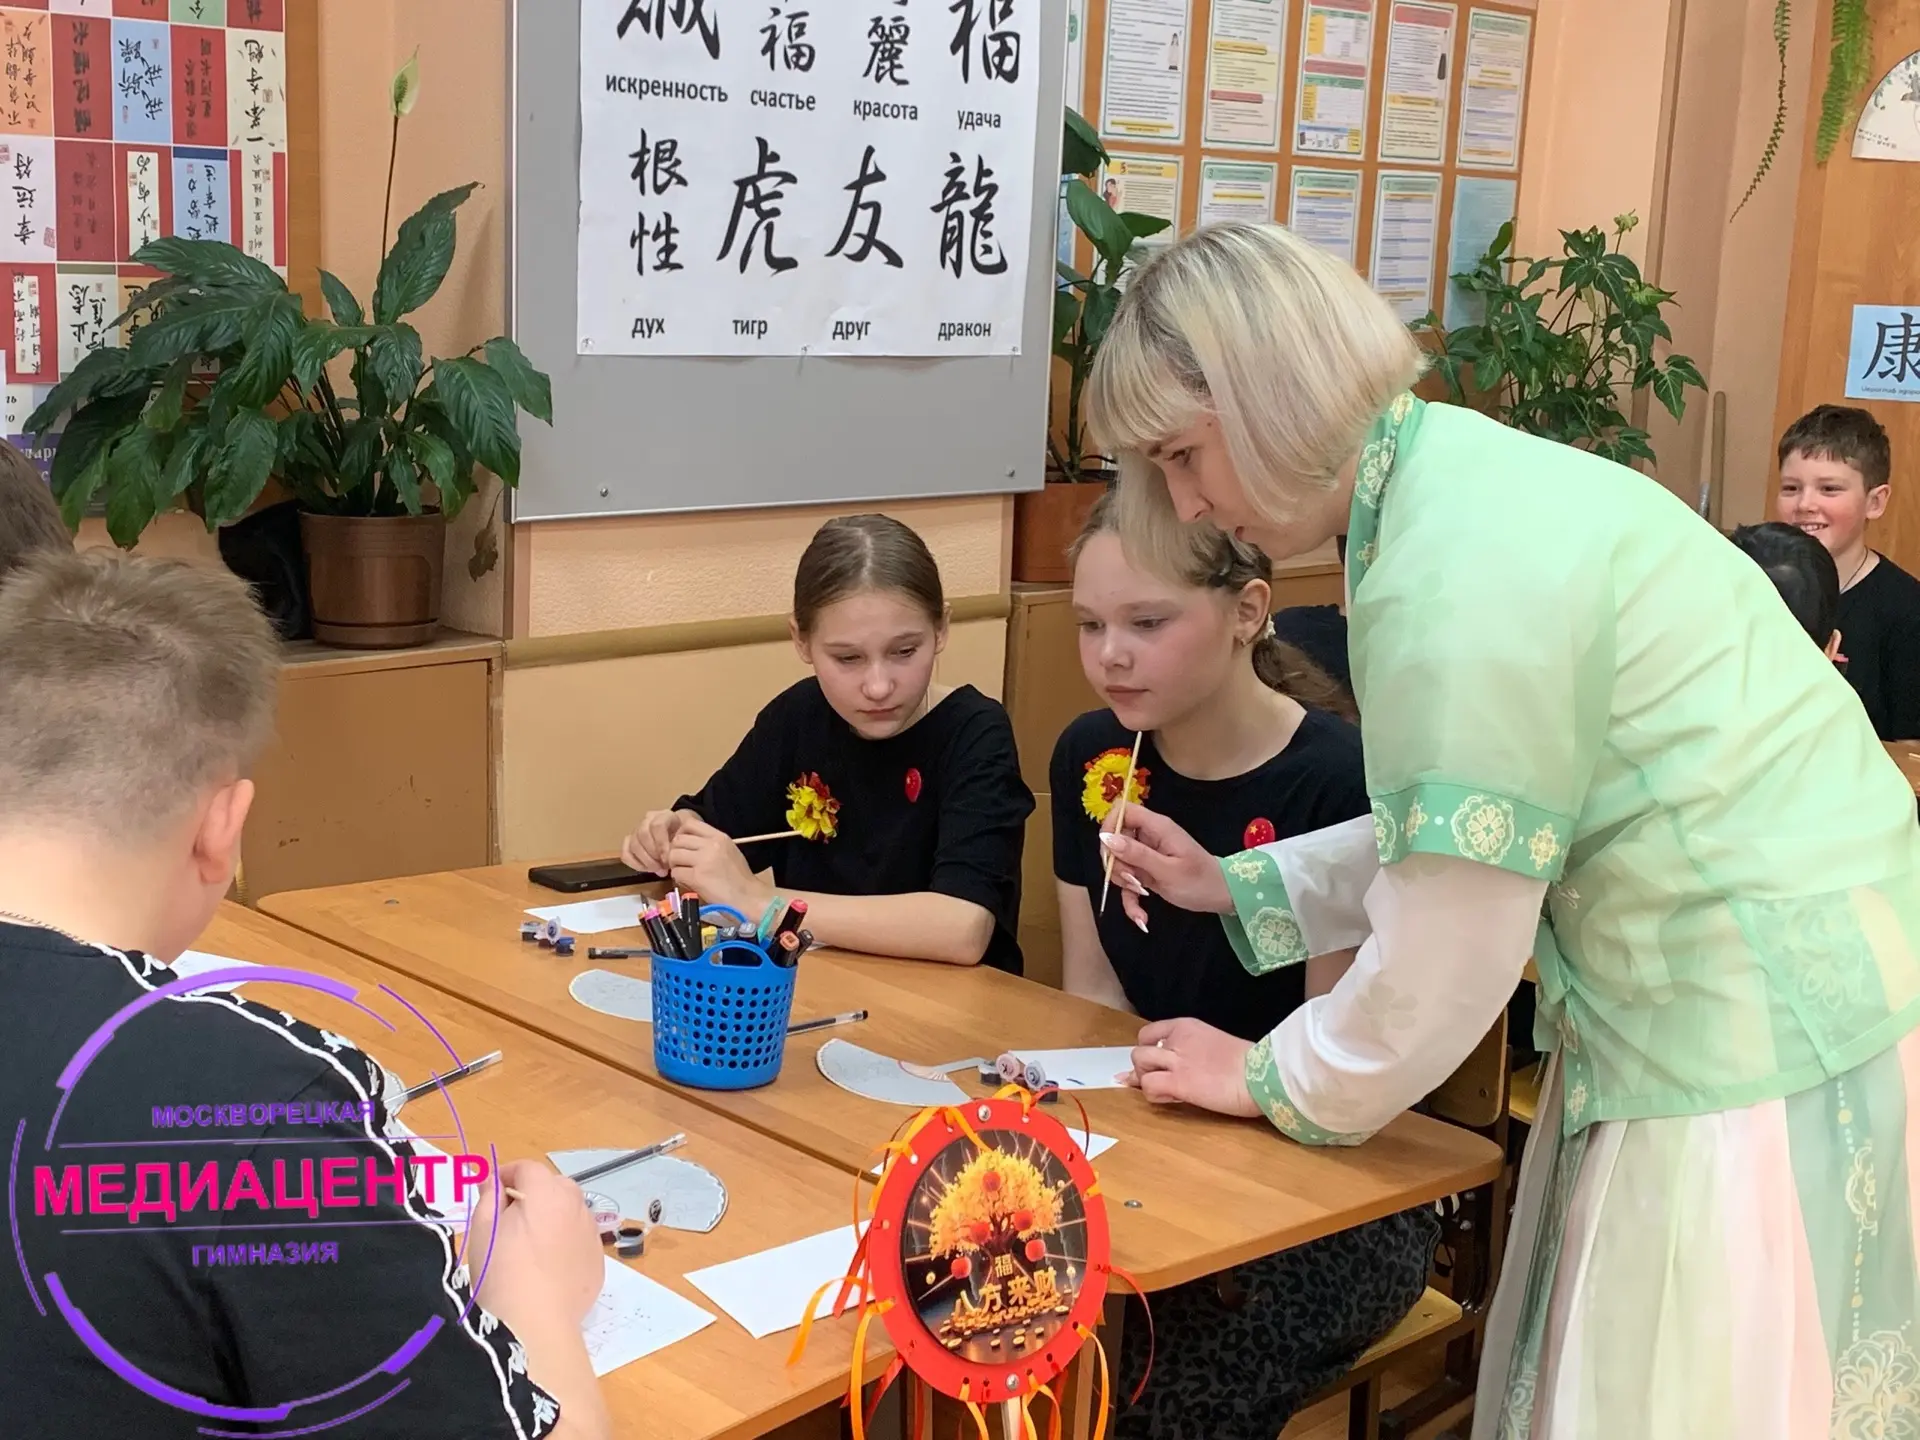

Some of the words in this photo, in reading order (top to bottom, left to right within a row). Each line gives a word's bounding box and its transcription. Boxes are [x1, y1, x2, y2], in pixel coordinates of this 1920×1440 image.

[760, 0, 816, 72] 福
[863, 0, 910, 85] 麗
[605, 74, 729, 104] искренность
[750, 89, 816, 112] счастье
[853, 99, 919, 122] красота
[957, 108, 1002, 131] удача
[716, 136, 799, 277] 虎
[824, 145, 904, 269] 友
[929, 152, 1008, 279] 龍
[631, 315, 666, 338] дух
[732, 318, 768, 338] тигр
[831, 318, 872, 338] друг
[937, 319, 992, 338] дракон
[1862, 312, 1920, 383] 康
